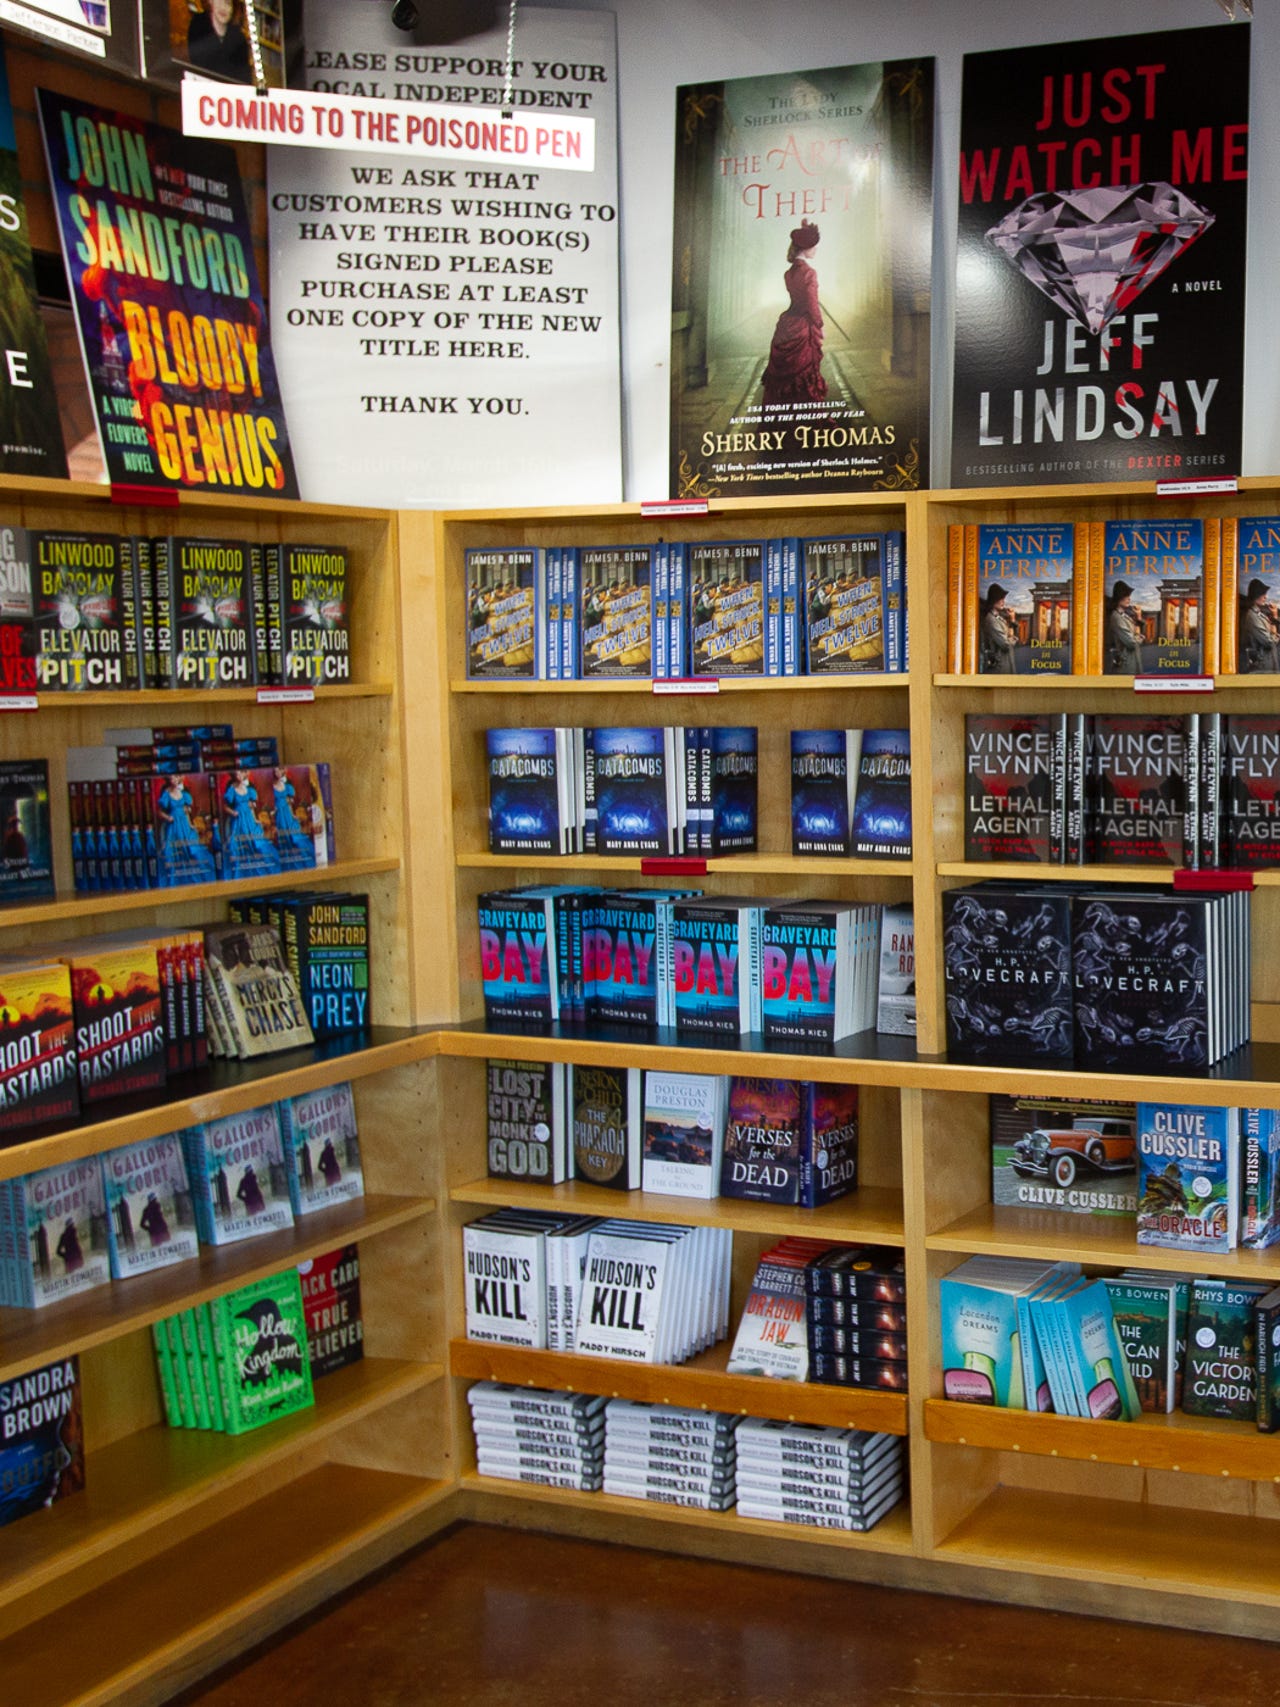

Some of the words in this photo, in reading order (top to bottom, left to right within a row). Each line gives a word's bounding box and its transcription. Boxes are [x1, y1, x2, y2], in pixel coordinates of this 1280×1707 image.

[395, 55, 524, 78] SUPPORT
[532, 62, 608, 82] YOUR
[313, 80, 385, 99] OCAL
[394, 83, 592, 109] INDEPENDENT
[1036, 64, 1166, 131] JUST
[199, 95, 304, 135] COMING
[312, 105, 343, 138] TO
[351, 109, 399, 143] THE
[407, 115, 529, 154] POISONED
[535, 128, 582, 159] PEN
[743, 111, 812, 128] SHERLOCK
[818, 104, 864, 119] SERIES
[61, 110, 155, 201] JOHN
[720, 155, 761, 176] THE
[767, 134, 849, 176] ART
[959, 133, 1141, 204] WATCH
[1171, 123, 1249, 186] ME
[351, 166, 393, 186] WE
[401, 170, 457, 188] ASK
[466, 172, 539, 190] THAT
[272, 193, 442, 216] CUSTOMERS
[451, 201, 573, 221] WISHING
[581, 204, 616, 222] TO
[742, 183, 854, 219] THEFT
[68, 194, 250, 299] SANDFORD
[299, 222, 376, 242] HAVE
[384, 225, 472, 245] THEIR
[479, 229, 591, 253] BOOK(S)
[337, 252, 441, 273] SIGNED
[450, 255, 553, 275] PLEASE
[300, 281, 450, 300] PURCHASE
[458, 284, 494, 302] AT
[502, 286, 589, 305] LEAST
[1172, 283, 1179, 293] A
[1185, 280, 1223, 292] NOVEL
[286, 309, 344, 327] ONE
[352, 310, 426, 329] COPY
[433, 312, 471, 329] OF
[478, 314, 533, 332] THE
[541, 315, 602, 333] NEW
[122, 300, 263, 398] BLOODY
[359, 339, 441, 357] TITLE
[448, 341, 530, 359] HERE.
[1036, 313, 1160, 376] JEFF
[360, 396, 458, 415] THANK
[467, 397, 530, 416] YOU.
[729, 415, 762, 425] AUTHOR
[778, 413, 794, 422] THE
[796, 411, 829, 421] HOLLOW
[765, 403, 791, 412] TODAY
[793, 400, 847, 411] BESTSELLING
[978, 378, 1220, 447] LINDSAY
[107, 423, 150, 447] FLOWERS
[150, 400, 286, 490] GENIUS
[701, 430, 787, 457] SHERRY
[794, 424, 896, 449] THOMAS
[124, 452, 154, 473] NOVEL
[966, 462, 1034, 476] BESTSELLING
[1040, 460, 1081, 474] AUTHOR
[1087, 459, 1100, 470] OF
[1102, 458, 1123, 470] THE
[1127, 455, 1182, 470] DEXTER
[1186, 454, 1226, 466] SERIES
[38, 541, 115, 568] LINWOOD
[808, 543, 838, 555] JAMES
[840, 544, 849, 553] R.
[851, 541, 877, 553] BENN
[986, 534, 1063, 556] ANNE
[181, 546, 243, 572] LINWOOD
[983, 556, 1066, 580] PERRY
[41, 628, 120, 653] ELEVATOR
[182, 628, 247, 652] ELEVATOR
[823, 614, 879, 655] TWELVE
[42, 658, 122, 684] PITCH
[183, 656, 248, 681] PITCH
[968, 732, 1050, 753] VINCE
[1097, 734, 1183, 756] VINCE
[492, 758, 554, 778] CATACOMBS
[967, 755, 1051, 776] FLYNN
[1098, 756, 1184, 777] FLYNN
[970, 796, 1049, 814] LETHAL
[974, 816, 1045, 835] AGENT
[308, 905, 340, 925] JOHN
[309, 925, 367, 947] SANDFORD
[763, 918, 837, 947] GRAVEYARD
[309, 964, 354, 990] NEON
[763, 945, 837, 1004] BAY
[1128, 965, 1141, 975] H.
[1143, 966, 1155, 976] P.
[248, 1001, 305, 1038] CHASE
[312, 992, 367, 1029] PREY
[76, 1005, 134, 1052] SHOOT
[770, 1025, 805, 1036] THOMAS
[808, 1026, 828, 1038] KIES
[80, 1026, 164, 1086] BASTARDS
[653, 1083, 708, 1099] DOUGLAS
[654, 1095, 706, 1109] PRESTON
[213, 1115, 272, 1149] GALLOWS
[735, 1125, 792, 1148] VERSES
[1155, 1110, 1206, 1138] CLIVE
[488, 1141, 549, 1177] GOD
[1141, 1134, 1221, 1161] CUSSLER
[731, 1164, 789, 1188] DEAD
[1159, 1213, 1222, 1239] ORACLE
[588, 1256, 657, 1289] HUDSON'S
[590, 1289, 645, 1332] KILL
[747, 1292, 804, 1319] DRAGON
[234, 1312, 297, 1348] Hollow
[237, 1342, 303, 1379] Kingdom
[580, 1340, 608, 1353] PADDY
[610, 1346, 646, 1359] HIRSCH
[1218, 1345, 1241, 1359] THE
[0, 1361, 76, 1411] SANDRA
[1193, 1380, 1258, 1402] GARDEN
[4, 1389, 74, 1440] BROWN
